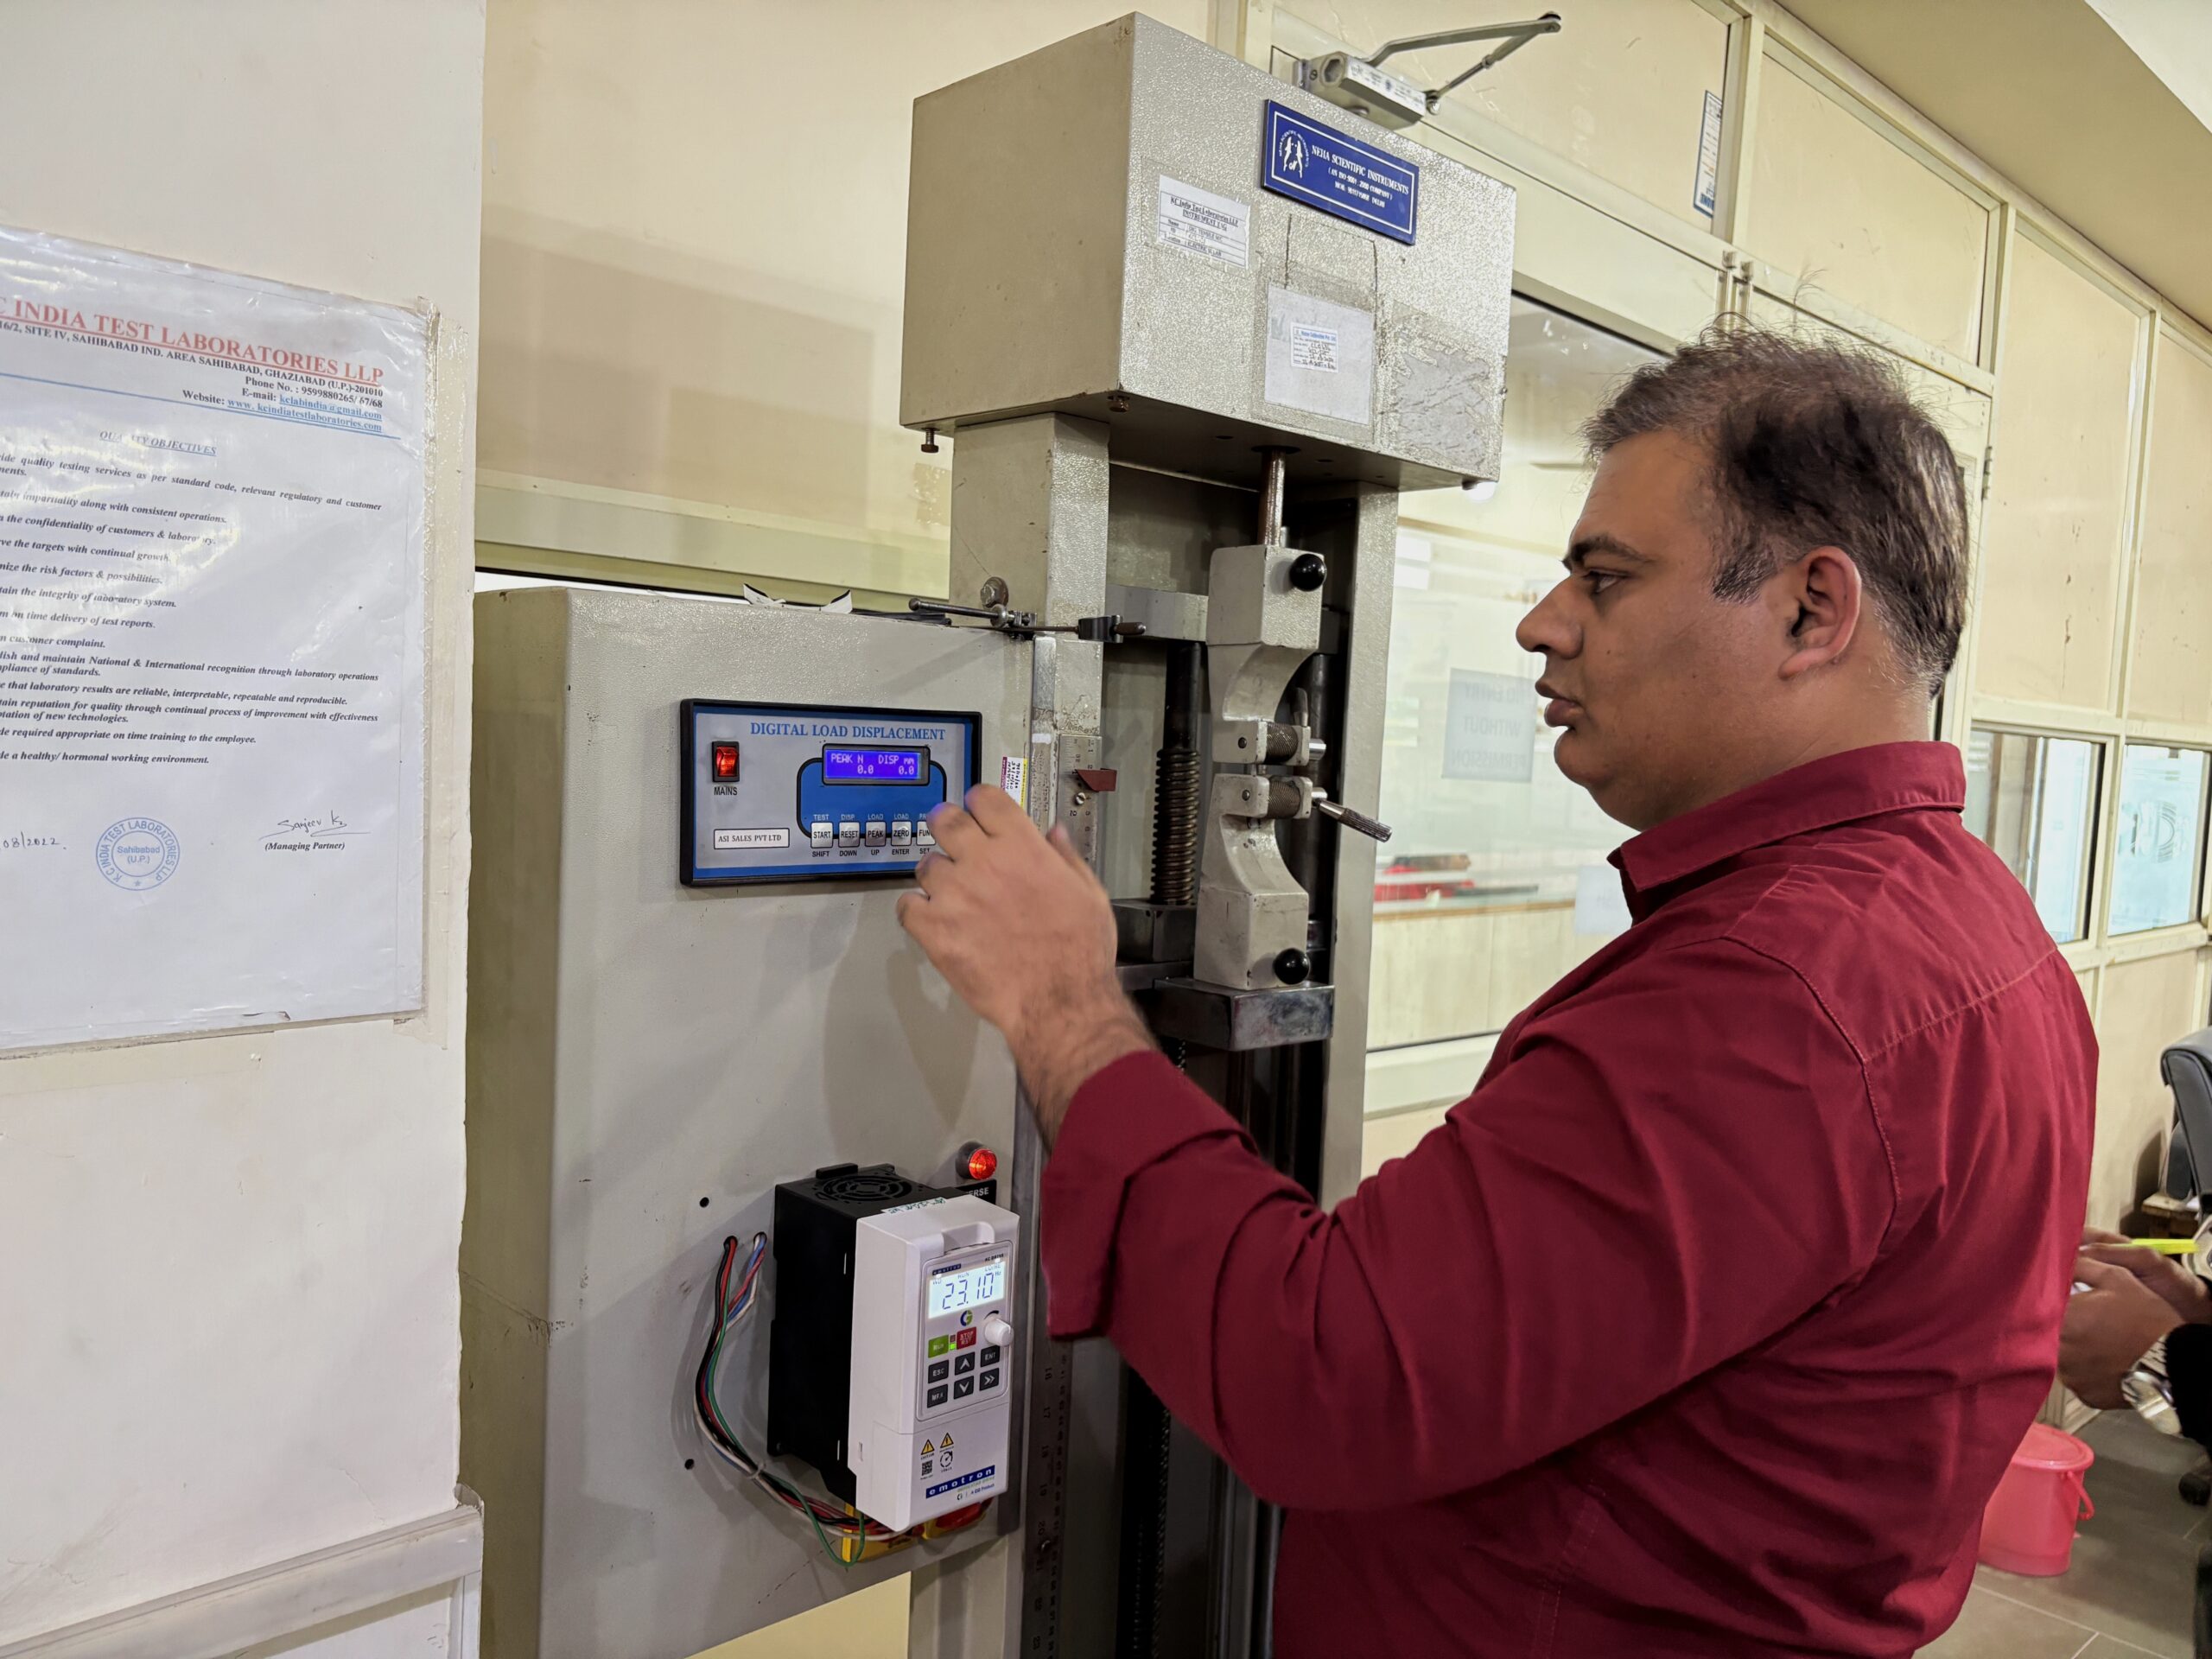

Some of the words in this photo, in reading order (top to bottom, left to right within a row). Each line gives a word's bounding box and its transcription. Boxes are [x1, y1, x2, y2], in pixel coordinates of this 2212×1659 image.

[1312, 145, 1331, 162] NEHA
[1332, 154, 1366, 176] SCIENTIFIC
[1368, 168, 1409, 194] INSTRUMENTS
[15, 300, 86, 329] INDIA
[94, 314, 154, 340] TEST
[162, 326, 338, 375] LABORATORIES
[346, 363, 384, 383] LLP
[25, 325, 52, 339] SITE
[54, 330, 69, 342] IV,
[72, 334, 138, 353] SAHIBABAD
[141, 345, 163, 358] IND.
[167, 351, 196, 364] AREA
[199, 357, 263, 376] SAHIBABAD,
[264, 370, 326, 387] GHAZIABAD
[327, 380, 384, 397] (U.P.)-201010
[182, 390, 225, 405] Website:
[242, 387, 276, 402] E-mail:
[245, 376, 275, 390] Phone
[276, 383, 293, 393] No.
[302, 386, 357, 404] 9599880265/
[359, 396, 383, 408] 67/68
[150, 437, 216, 455] OBJECTIVES
[21, 457, 54, 469] quality
[95, 466, 131, 477] services
[172, 477, 211, 487] standard
[280, 493, 322, 505] regulatory
[346, 501, 382, 510] customer
[25, 518, 93, 532] confidentiality
[96, 524, 107, 534] of
[108, 527, 155, 537] customers
[40, 662, 51, 675] of
[53, 663, 100, 676] standards.
[42, 654, 85, 664] maintain
[89, 657, 130, 666] National
[145, 660, 205, 671] International
[207, 665, 256, 674] recognition
[258, 667, 292, 677] through
[295, 669, 336, 680] laboratory
[8, 681, 28, 690] that
[29, 682, 79, 694] laboratory
[133, 688, 169, 697] reliable,
[173, 689, 231, 700] interpretable,
[21, 700, 71, 711] reputation
[72, 701, 88, 714] for
[91, 702, 123, 715] quality
[125, 703, 162, 714] through
[243, 709, 254, 718] of
[253, 709, 308, 719] improvement
[329, 713, 378, 721] effectiveness
[67, 711, 128, 723] technologies.
[12, 728, 54, 738] required
[55, 730, 111, 740] appropriate
[149, 733, 186, 742] training
[215, 735, 256, 744] employee.
[751, 722, 809, 736] DIGITAL
[812, 724, 848, 738] LOAD
[852, 725, 945, 741] DISPLACEMENT
[62, 752, 109, 761] hormonal
[111, 754, 149, 764] working
[831, 753, 853, 764] PEAK
[857, 754, 863, 764] N
[878, 754, 899, 765] DISP
[857, 765, 874, 774] 0.0
[899, 766, 914, 775] 0.0
[714, 786, 738, 796] MAINS
[103, 823, 126, 842] TEST
[718, 835, 729, 843] ASI
[732, 834, 752, 842] SALES
[754, 834, 766, 842] PVT
[117, 845, 161, 854] Sahibabad
[127, 820, 177, 867] LABORATORIES
[264, 842, 311, 852] (Managing
[313, 842, 346, 851] Partner)
[99, 844, 111, 868] INDIA
[156, 865, 171, 881] LLP
[969, 1186, 989, 1197] ERSE
[942, 1273, 995, 1310] 23.10
[960, 1332, 974, 1340] STOP
[985, 1351, 996, 1361] ENT
[932, 1368, 944, 1376] ESC
[929, 1468, 993, 1496] emotron
